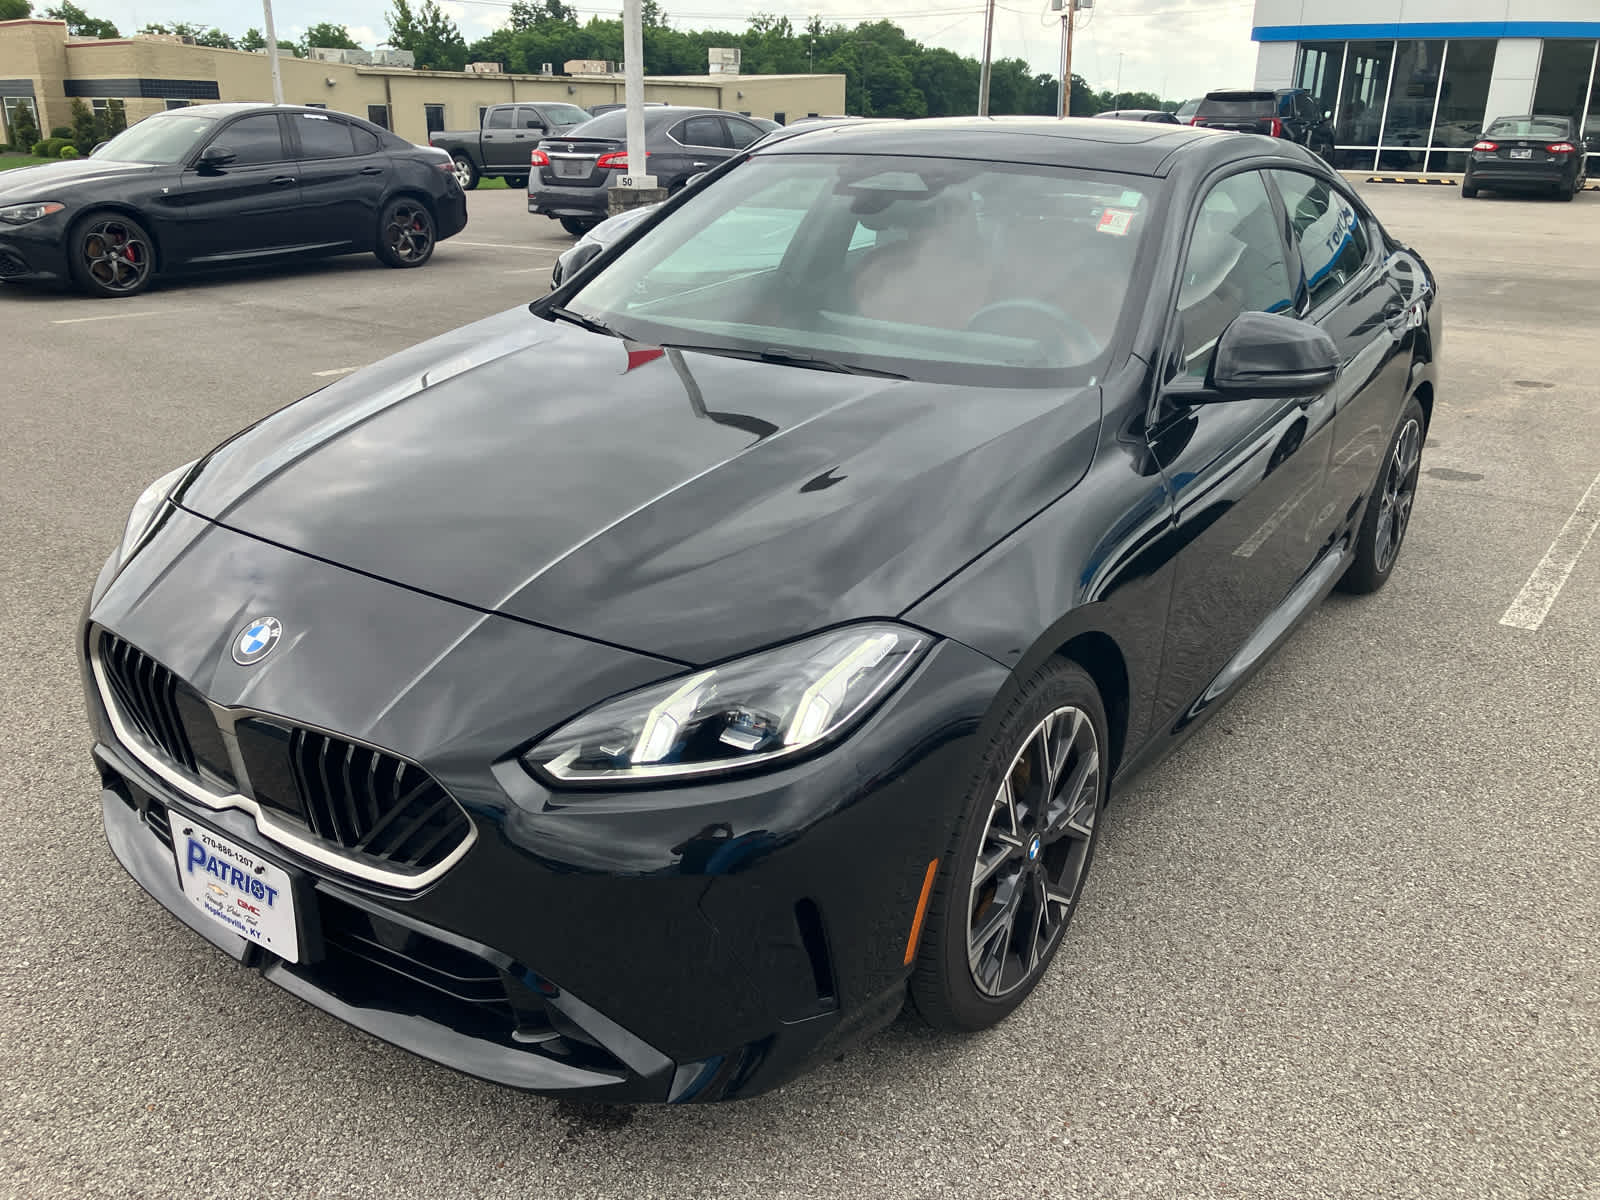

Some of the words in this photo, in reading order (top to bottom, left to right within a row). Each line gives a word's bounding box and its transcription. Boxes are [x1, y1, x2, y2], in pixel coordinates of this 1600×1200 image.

[622, 178, 632, 187] 50
[187, 838, 279, 906] PATRIOT
[237, 898, 261, 917] GMC
[250, 928, 262, 940] KY
